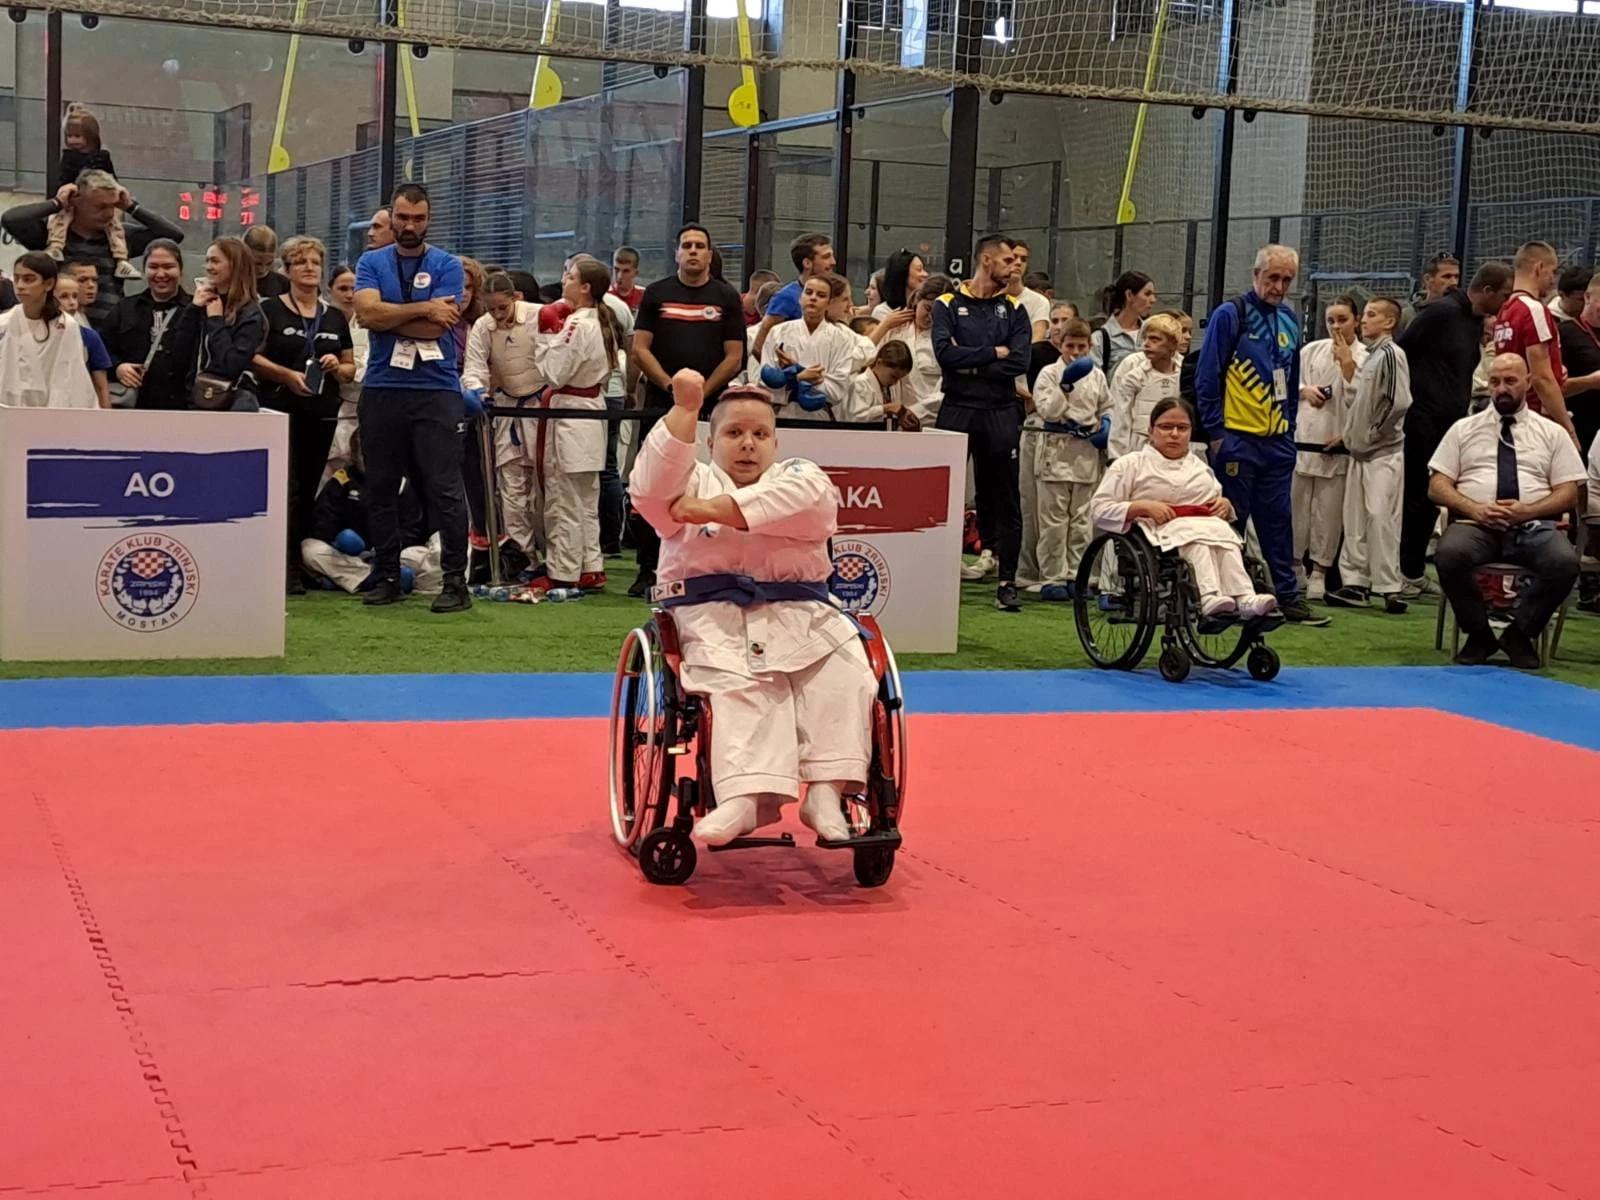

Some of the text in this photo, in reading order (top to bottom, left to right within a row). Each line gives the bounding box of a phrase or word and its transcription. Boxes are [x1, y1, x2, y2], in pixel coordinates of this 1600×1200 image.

[123, 471, 175, 498] AO
[100, 536, 196, 597] KARATE KLUB ZRINJSKI
[834, 543, 862, 555] KLUB
[865, 547, 888, 597] ZRINJSKI
[116, 610, 178, 629] MOSTAR
